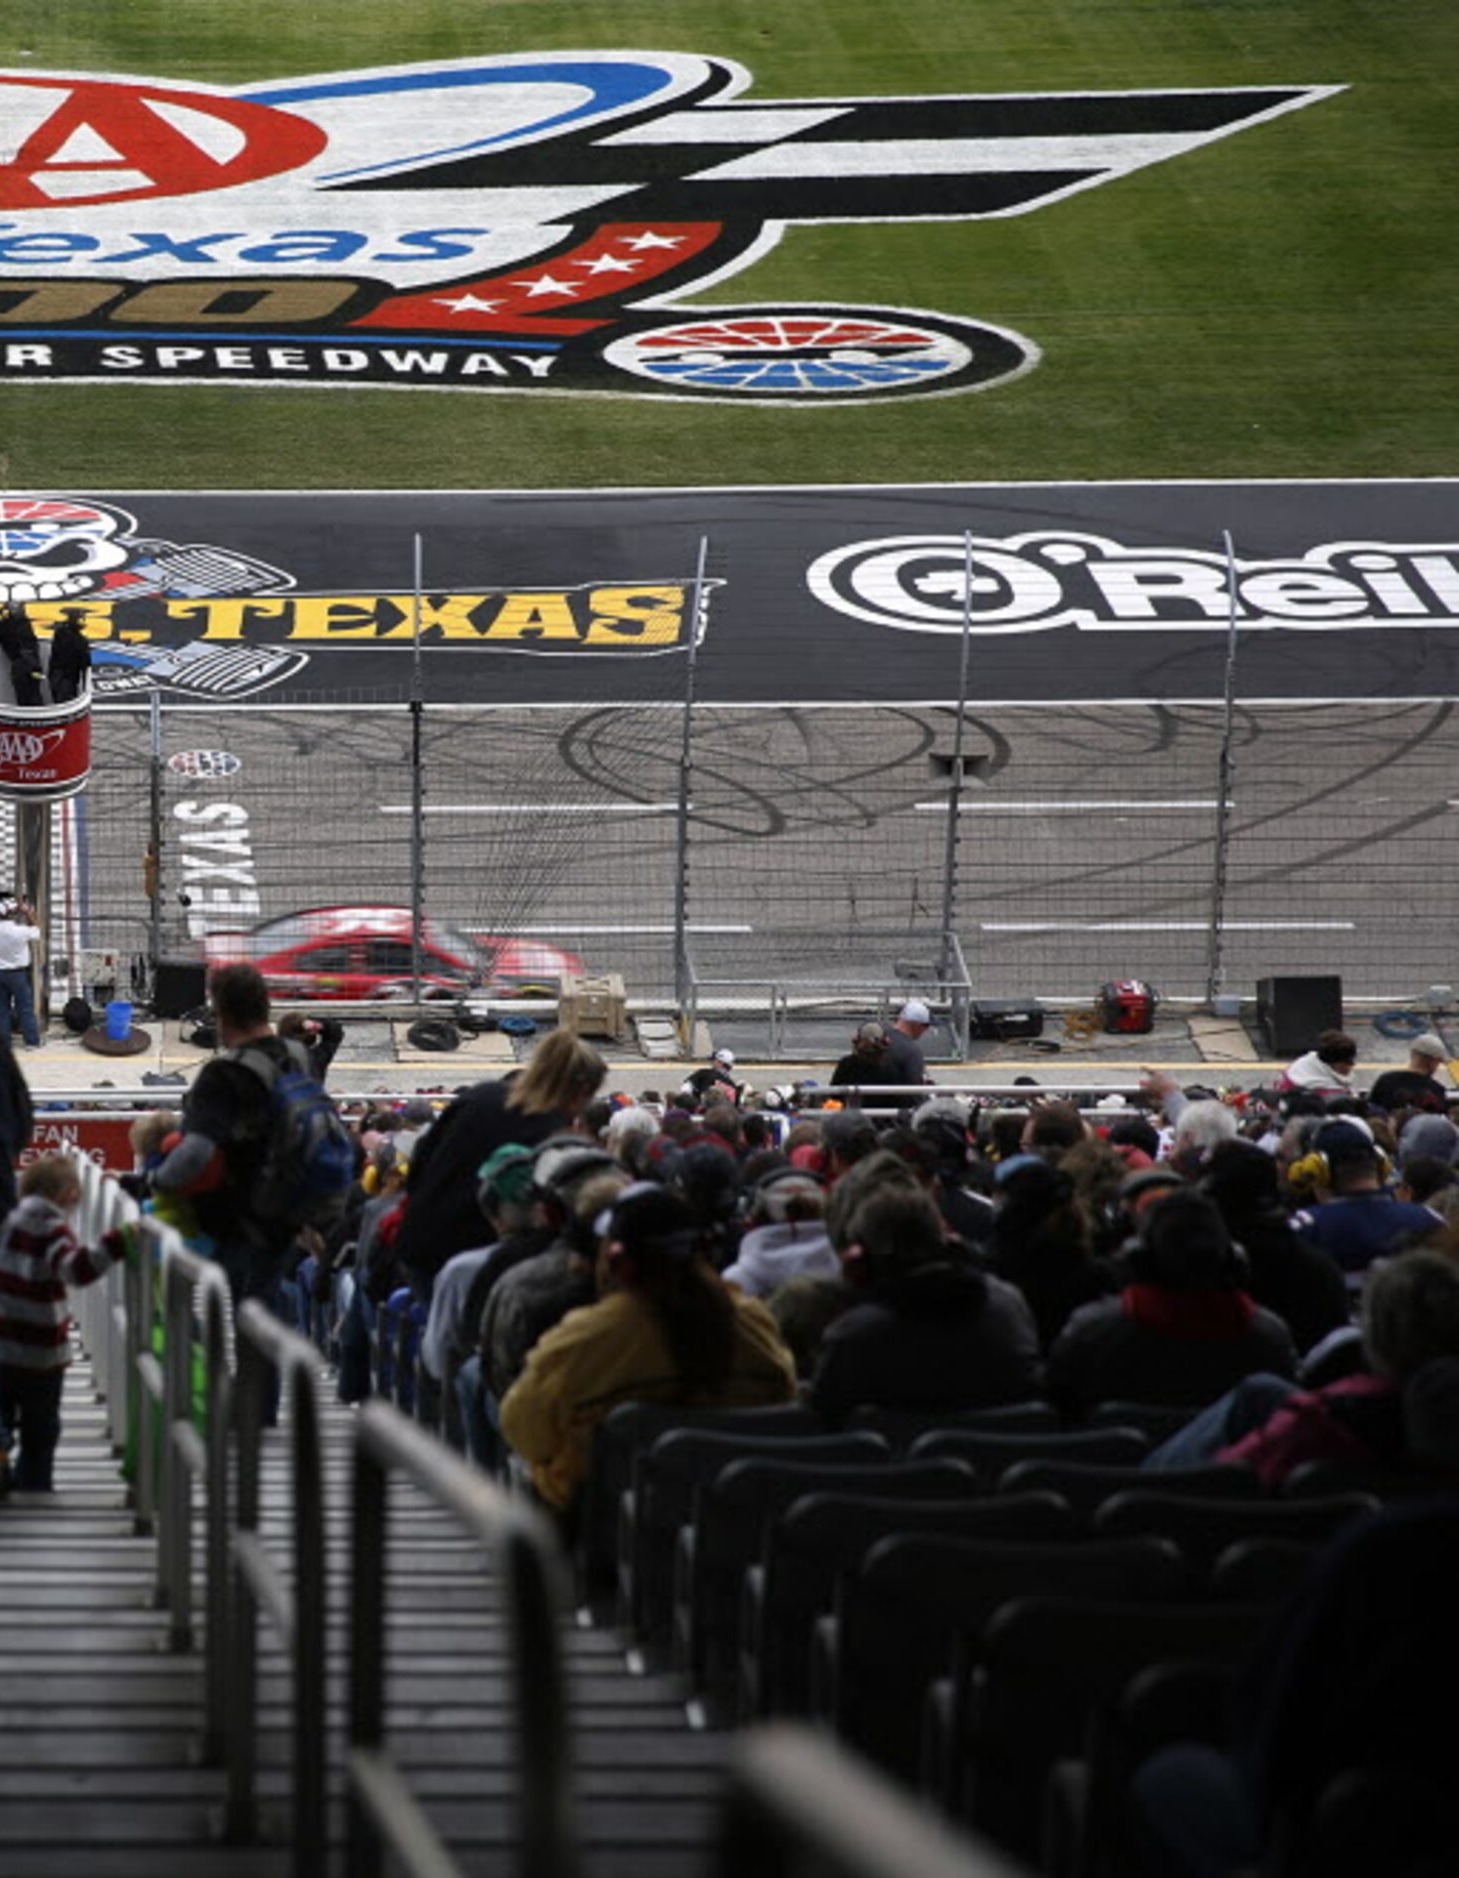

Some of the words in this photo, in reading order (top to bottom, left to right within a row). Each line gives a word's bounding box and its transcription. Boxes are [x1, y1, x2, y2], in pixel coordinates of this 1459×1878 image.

[101, 343, 560, 378] SPEEDWAY
[163, 586, 685, 645] TEXAS
[32, 1124, 79, 1144] FAN
